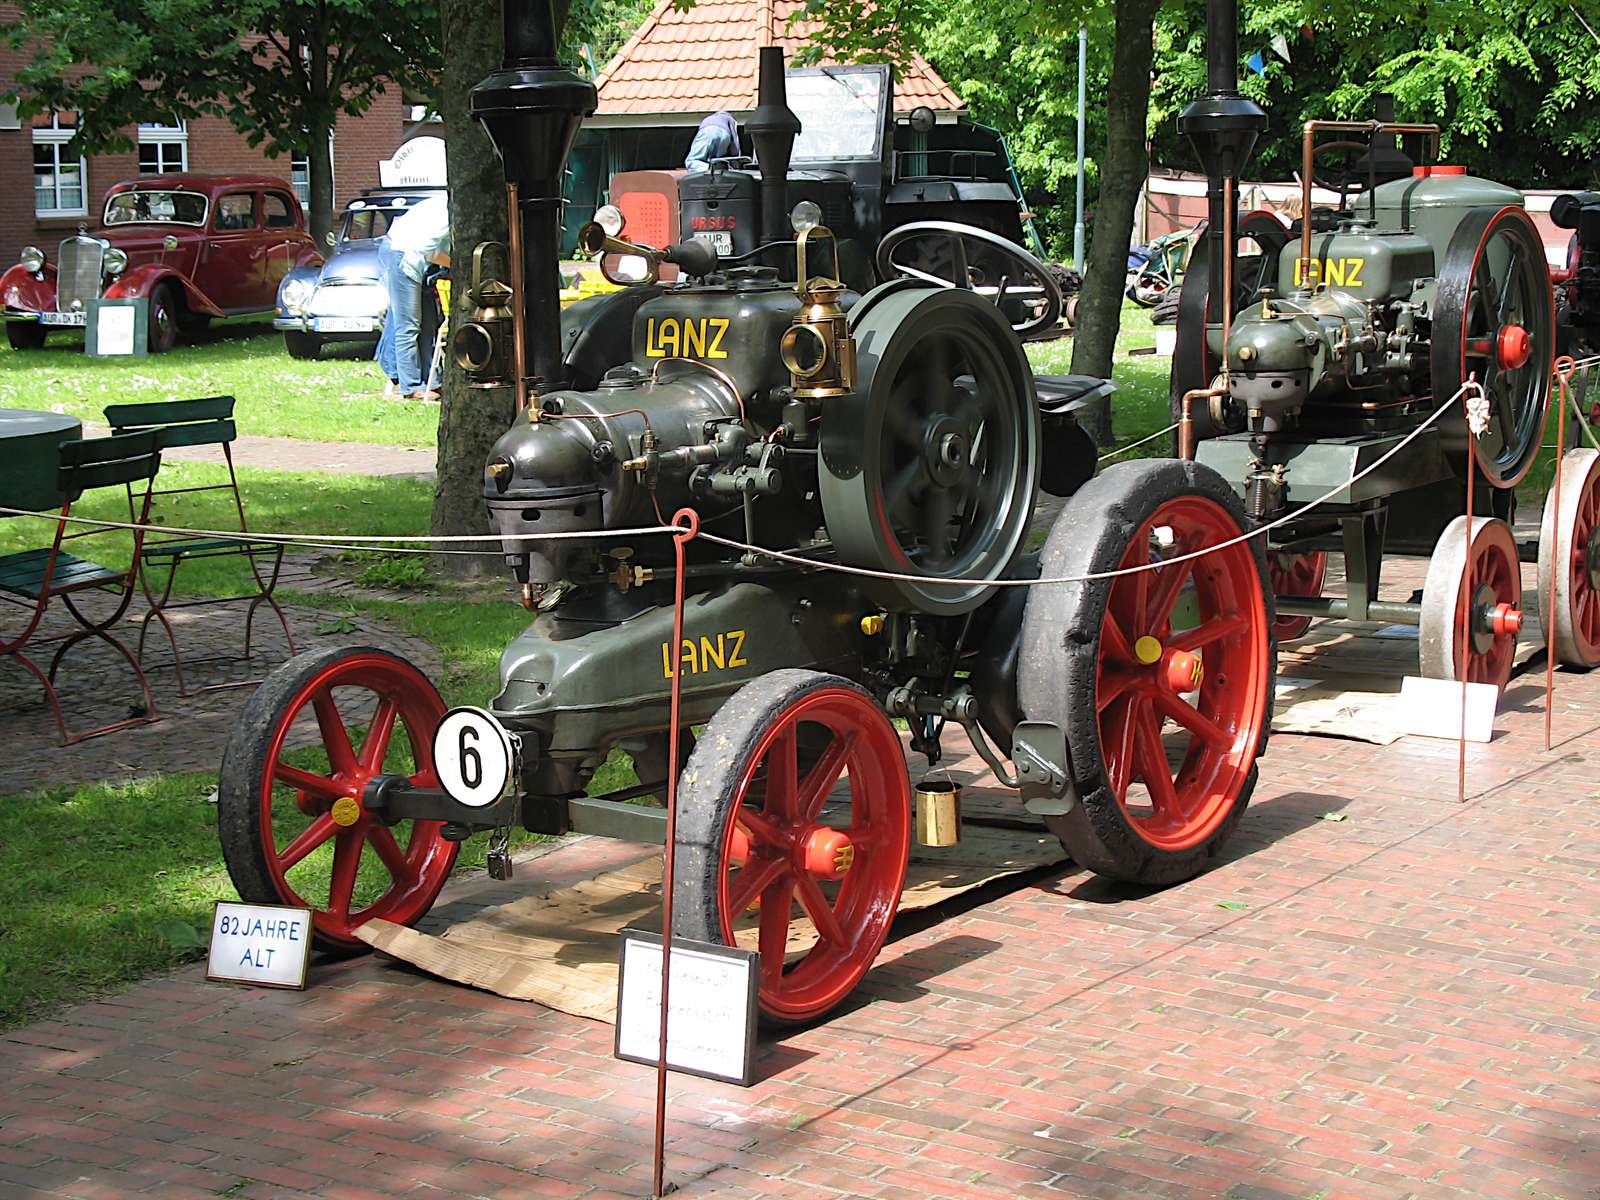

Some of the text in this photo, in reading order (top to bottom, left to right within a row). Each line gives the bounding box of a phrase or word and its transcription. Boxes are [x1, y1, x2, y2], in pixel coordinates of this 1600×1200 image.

[691, 215, 737, 231] URSUS
[1294, 257, 1365, 288] LANZ
[646, 317, 731, 359] LANZ
[661, 629, 748, 679] LANZ
[458, 725, 482, 790] 6
[240, 948, 276, 969] ALT
